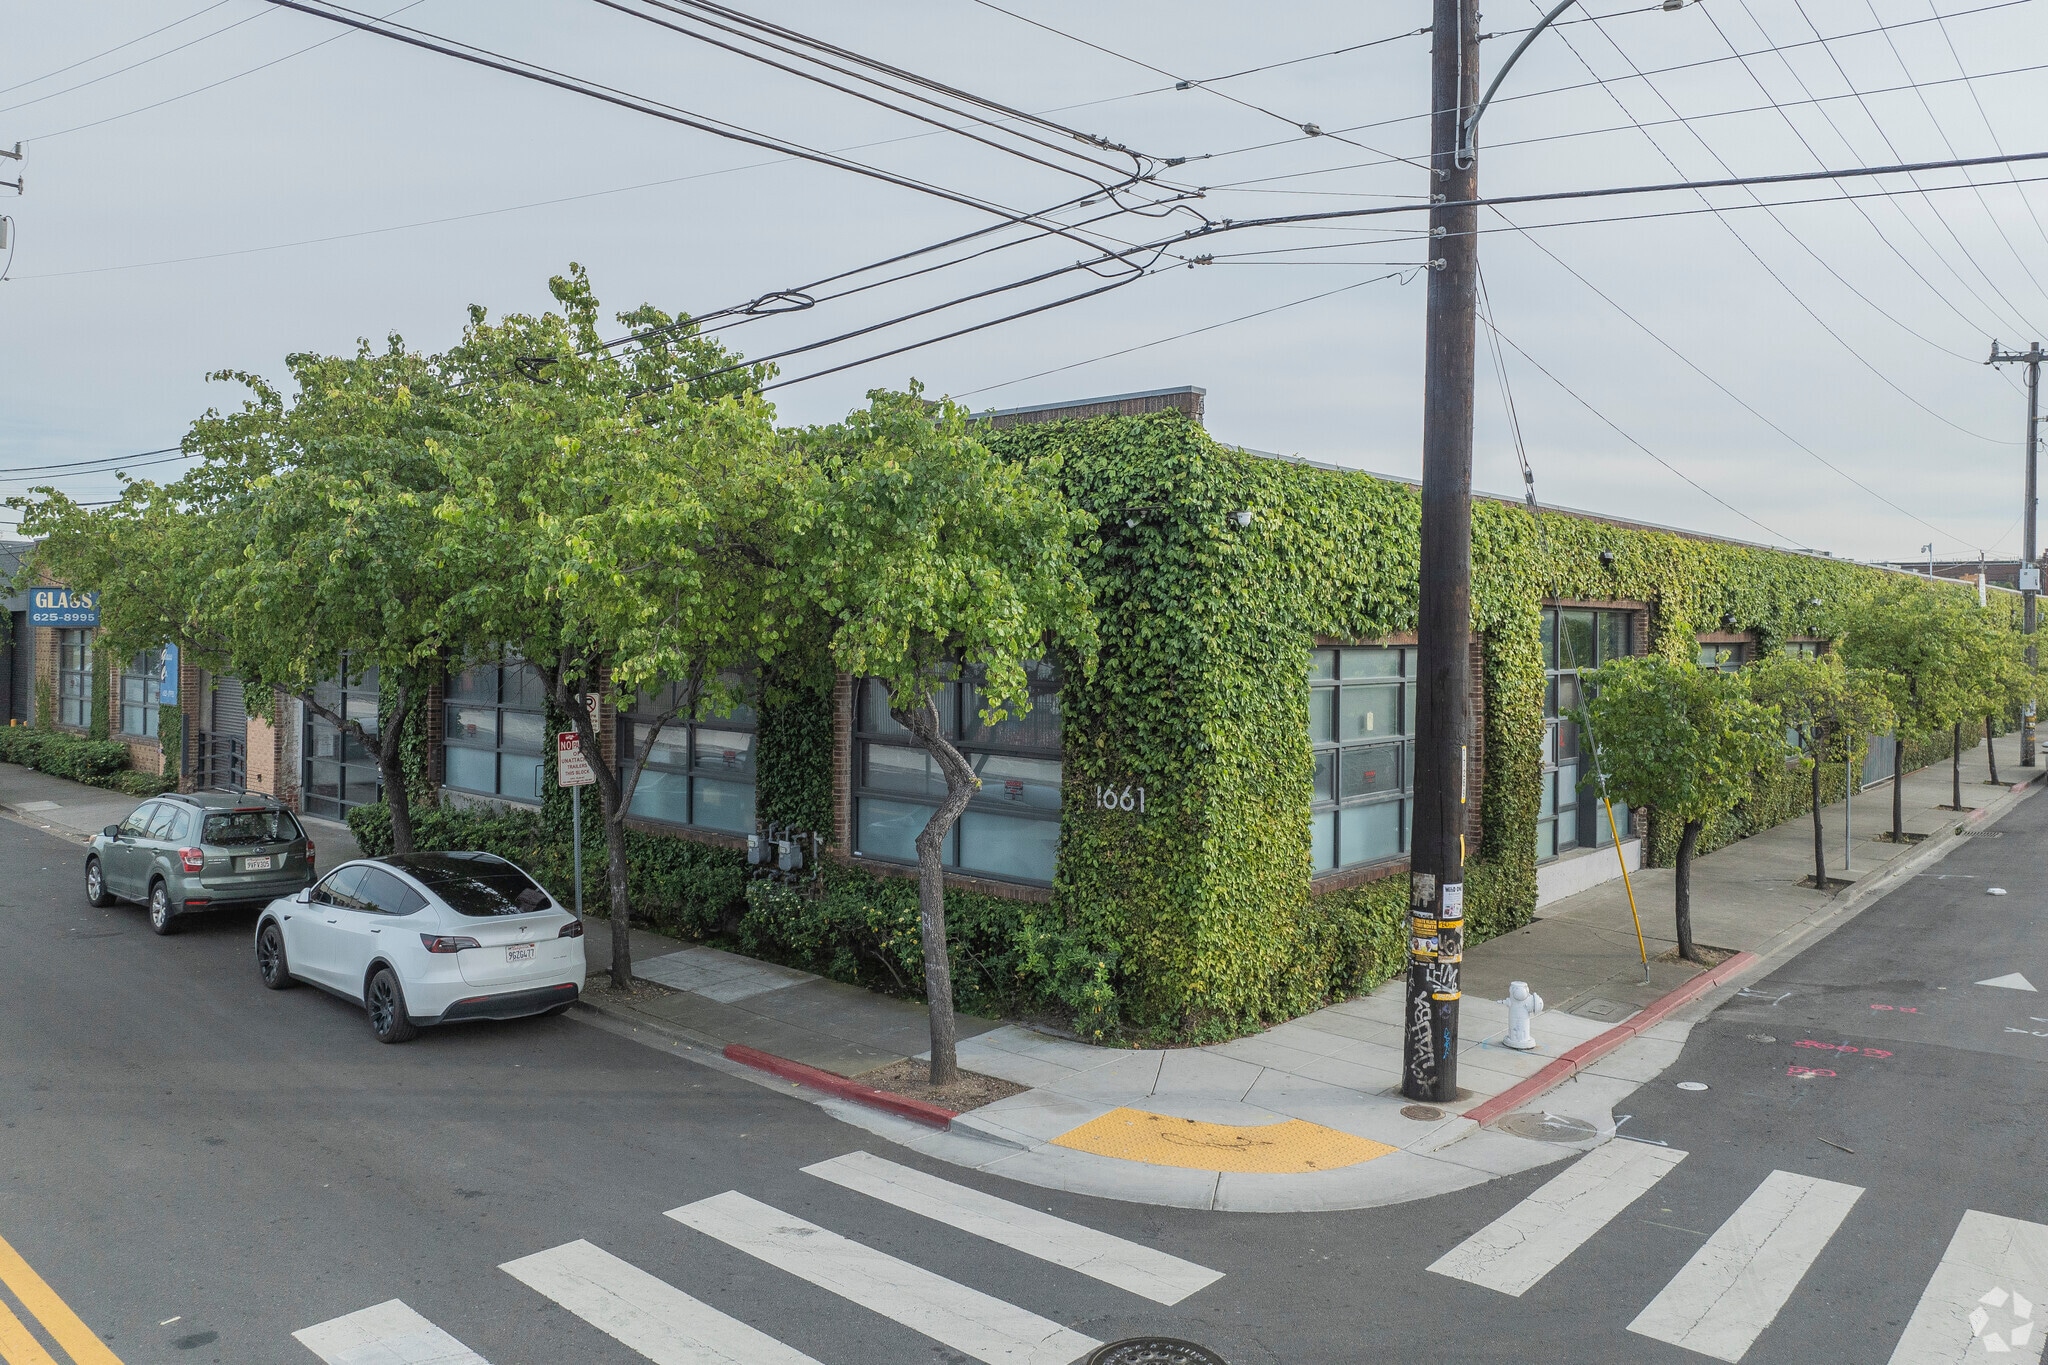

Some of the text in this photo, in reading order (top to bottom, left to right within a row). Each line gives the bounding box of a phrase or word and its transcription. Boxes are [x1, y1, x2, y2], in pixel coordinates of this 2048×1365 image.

[35, 591, 93, 608] GLASS
[33, 613, 95, 622] 625-8995
[560, 741, 572, 750] NO
[1097, 783, 1145, 813] 1661
